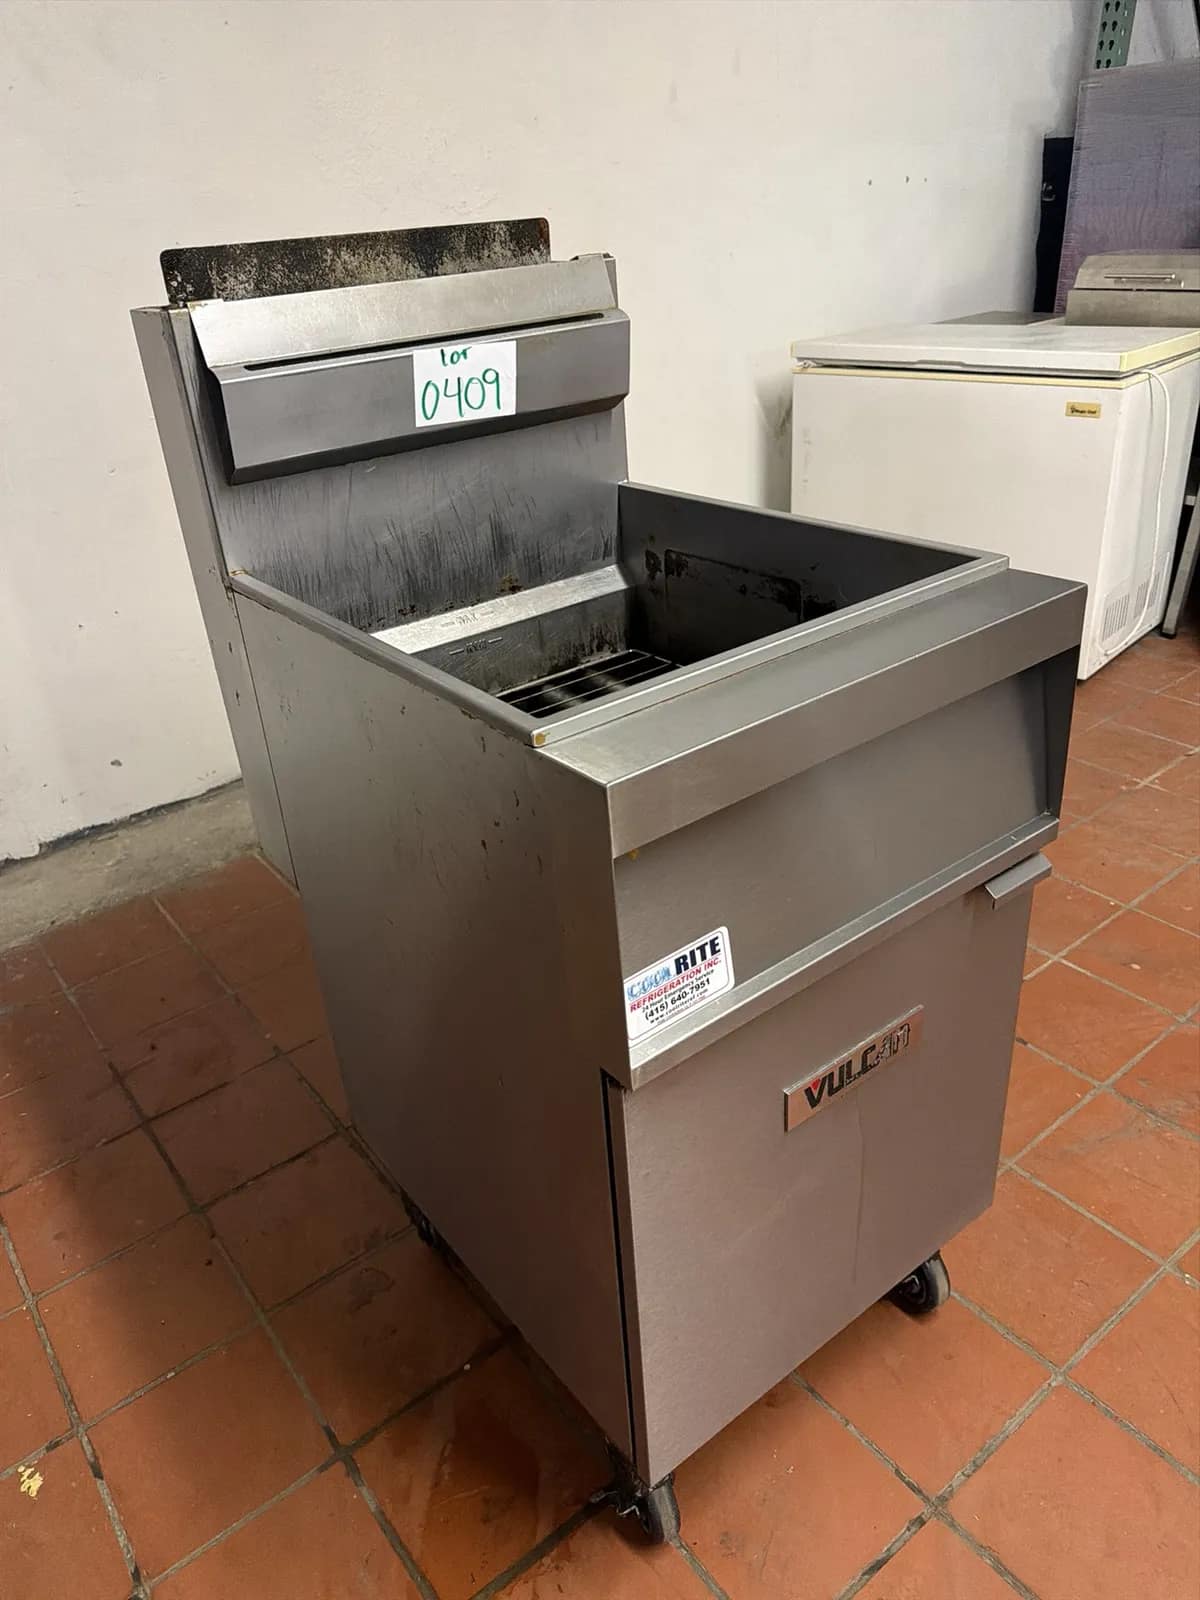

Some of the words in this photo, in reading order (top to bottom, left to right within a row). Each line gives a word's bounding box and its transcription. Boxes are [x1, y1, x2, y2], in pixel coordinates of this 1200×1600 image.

[421, 368, 501, 420] 0409
[674, 936, 721, 975] RITE
[630, 967, 702, 1012] REFRIGERATION
[704, 957, 721, 972] INC.
[645, 1001, 668, 1021] (415)
[671, 978, 710, 1005] 640-7951
[665, 981, 694, 1000] Emergency
[695, 969, 714, 981] Service
[804, 1023, 910, 1108] VULCAN
